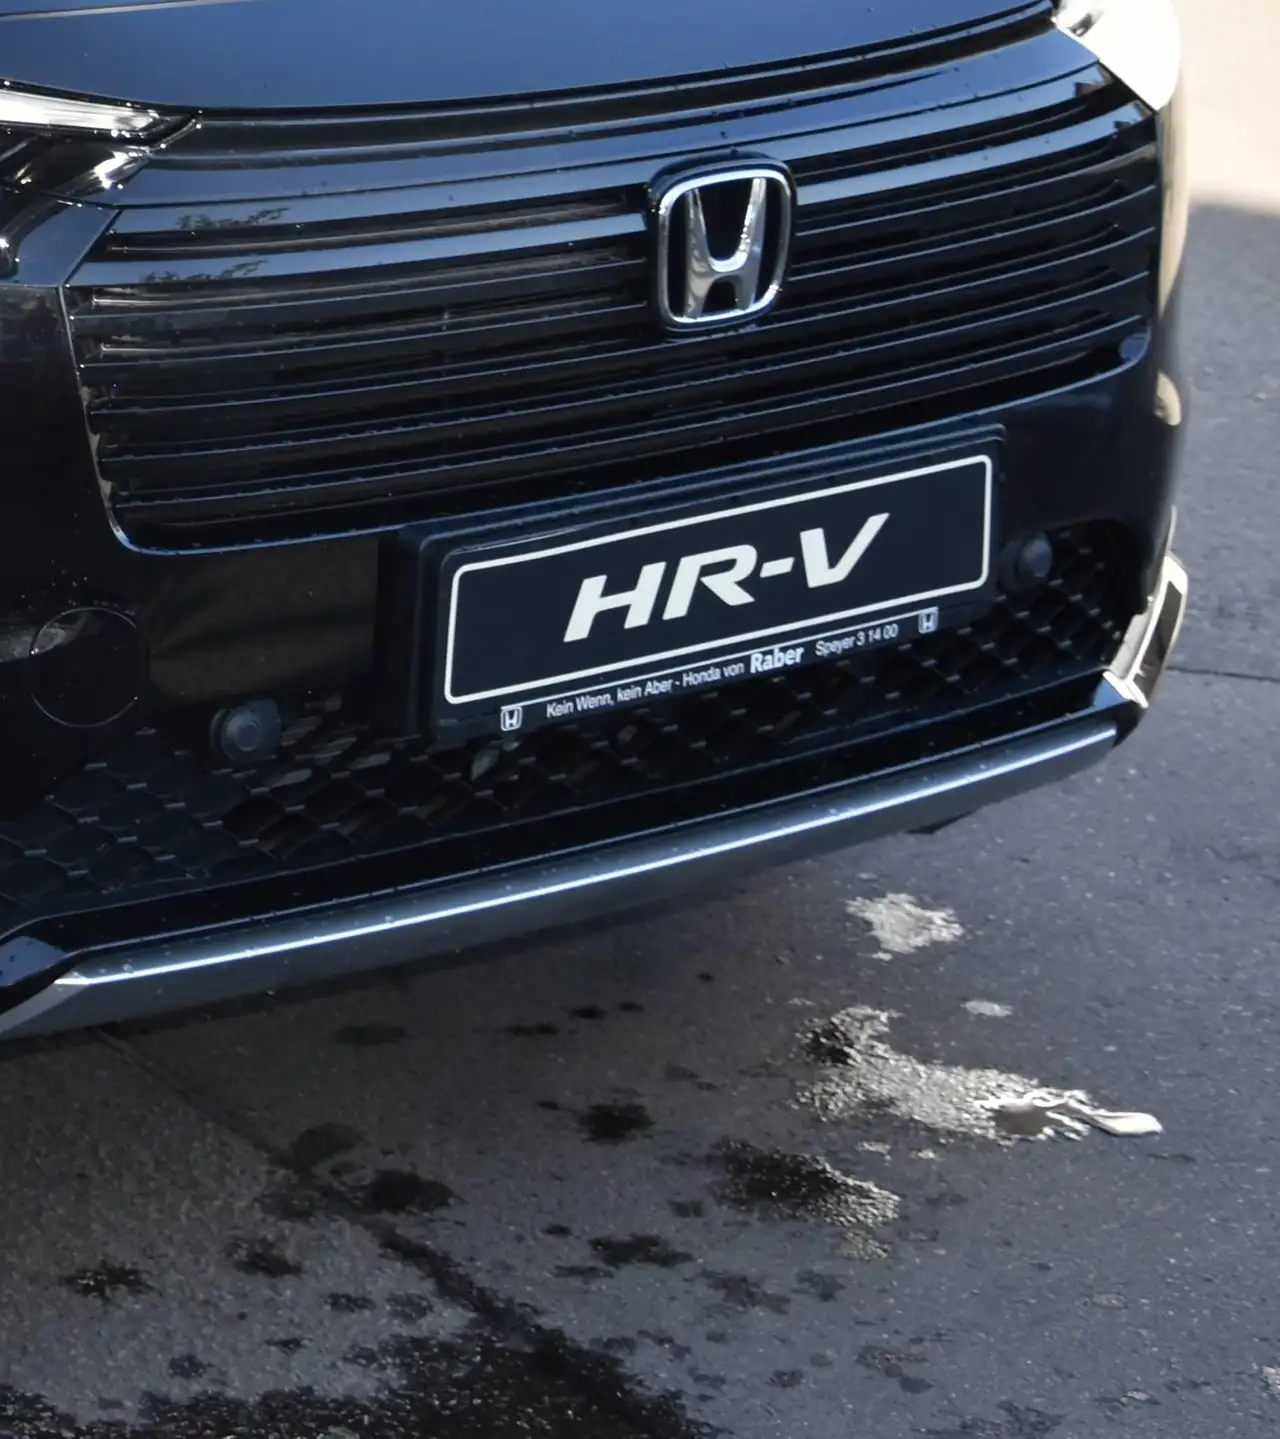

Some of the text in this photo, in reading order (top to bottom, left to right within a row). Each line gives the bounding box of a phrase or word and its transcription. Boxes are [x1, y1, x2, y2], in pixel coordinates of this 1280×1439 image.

[563, 513, 891, 642] HR-V
[546, 700, 574, 718] Kein
[575, 693, 614, 712] Wenn,
[616, 685, 642, 703] kein
[644, 678, 673, 696] Aber
[682, 666, 721, 688] Honda
[723, 662, 745, 678] von
[749, 647, 805, 674] Raber
[814, 635, 855, 658] Speyer
